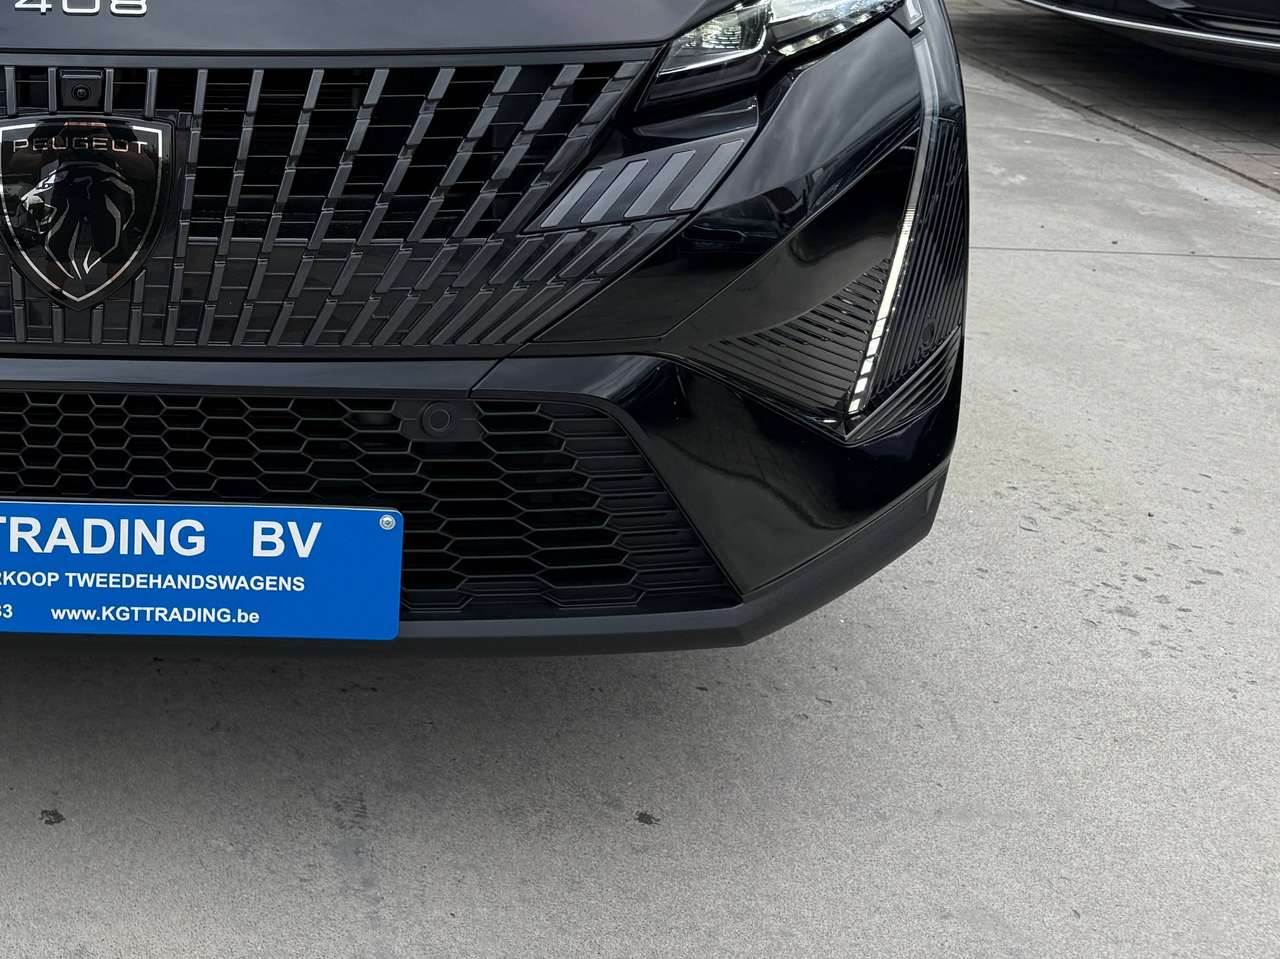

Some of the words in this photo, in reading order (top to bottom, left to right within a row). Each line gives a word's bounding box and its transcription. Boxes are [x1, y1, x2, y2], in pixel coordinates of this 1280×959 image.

[13, 136, 149, 154] PEUGEOT
[252, 520, 322, 558] BV
[65, 572, 305, 592] TWEEDEHANDSWAGENS
[51, 605, 260, 623] www.KGTTRADING.be
